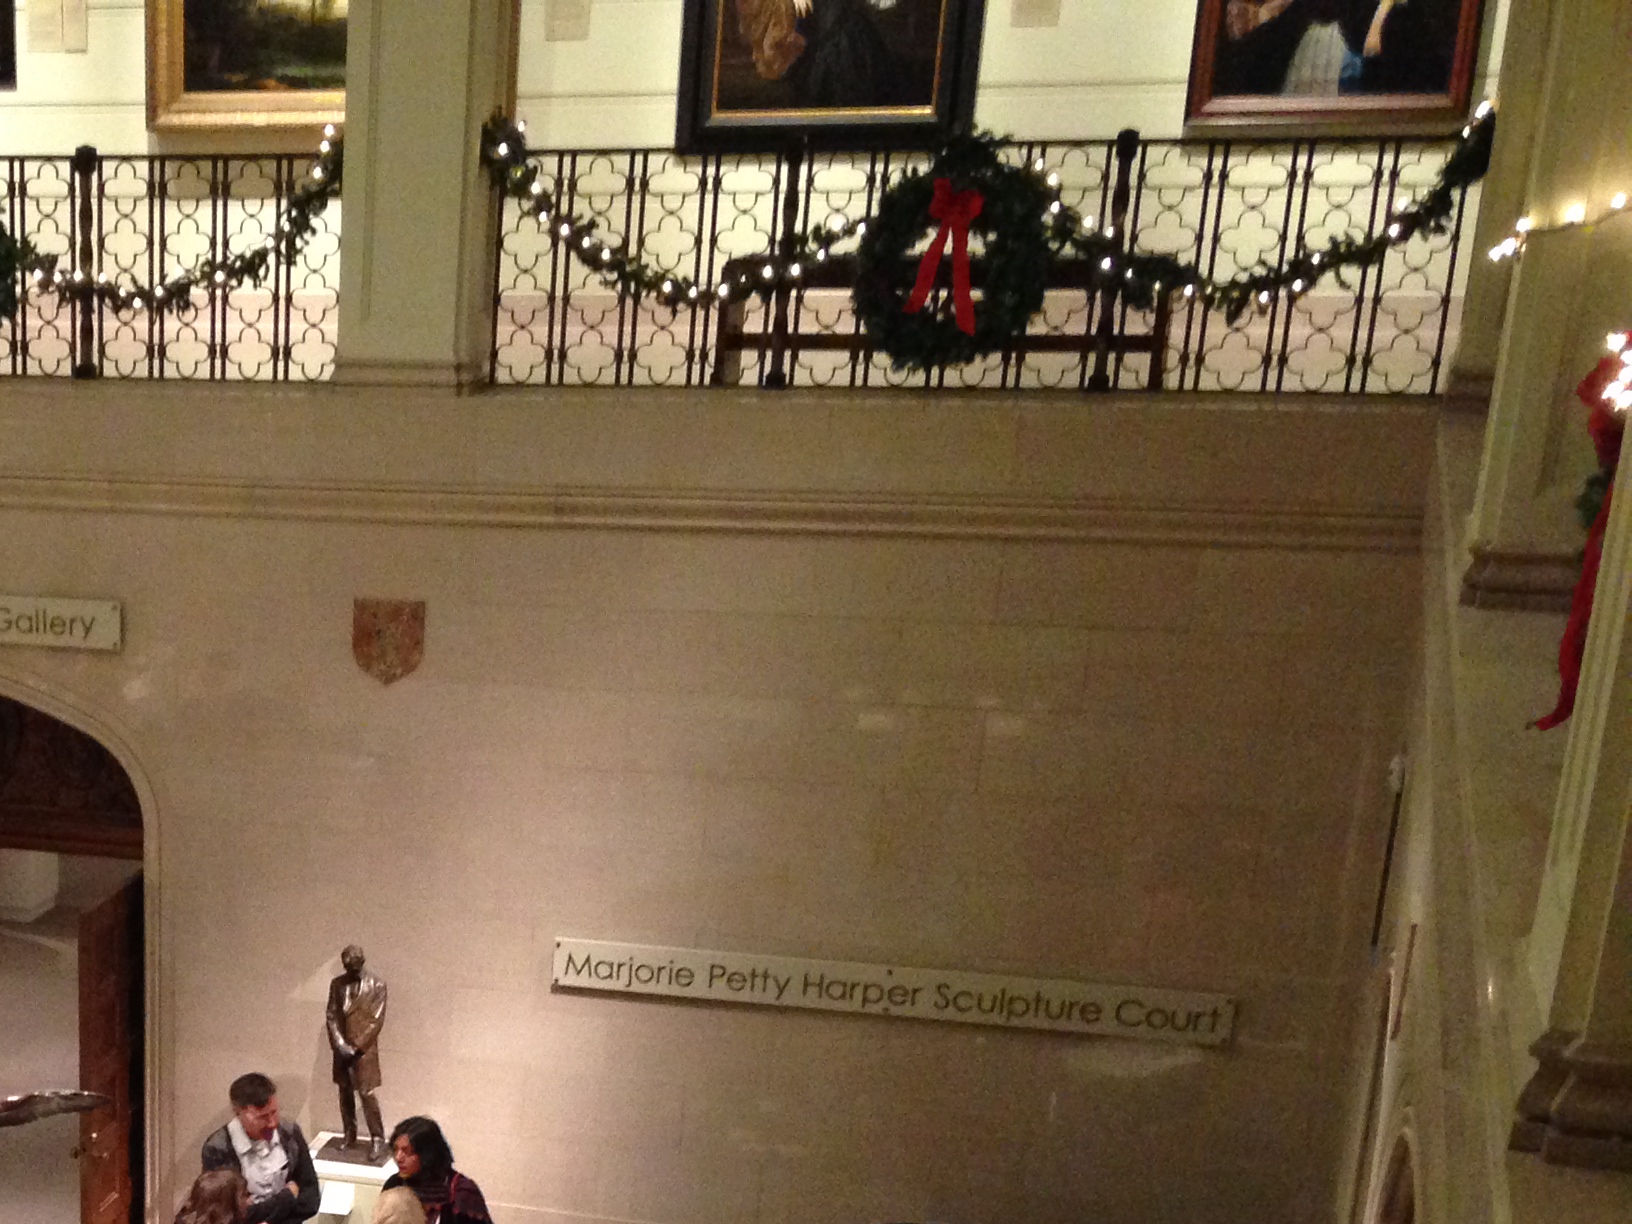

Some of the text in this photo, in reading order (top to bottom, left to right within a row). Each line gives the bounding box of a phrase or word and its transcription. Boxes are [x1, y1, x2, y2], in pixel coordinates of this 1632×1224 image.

[564, 952, 1223, 1034] Marjorie Petty Harper Sculpture Court
